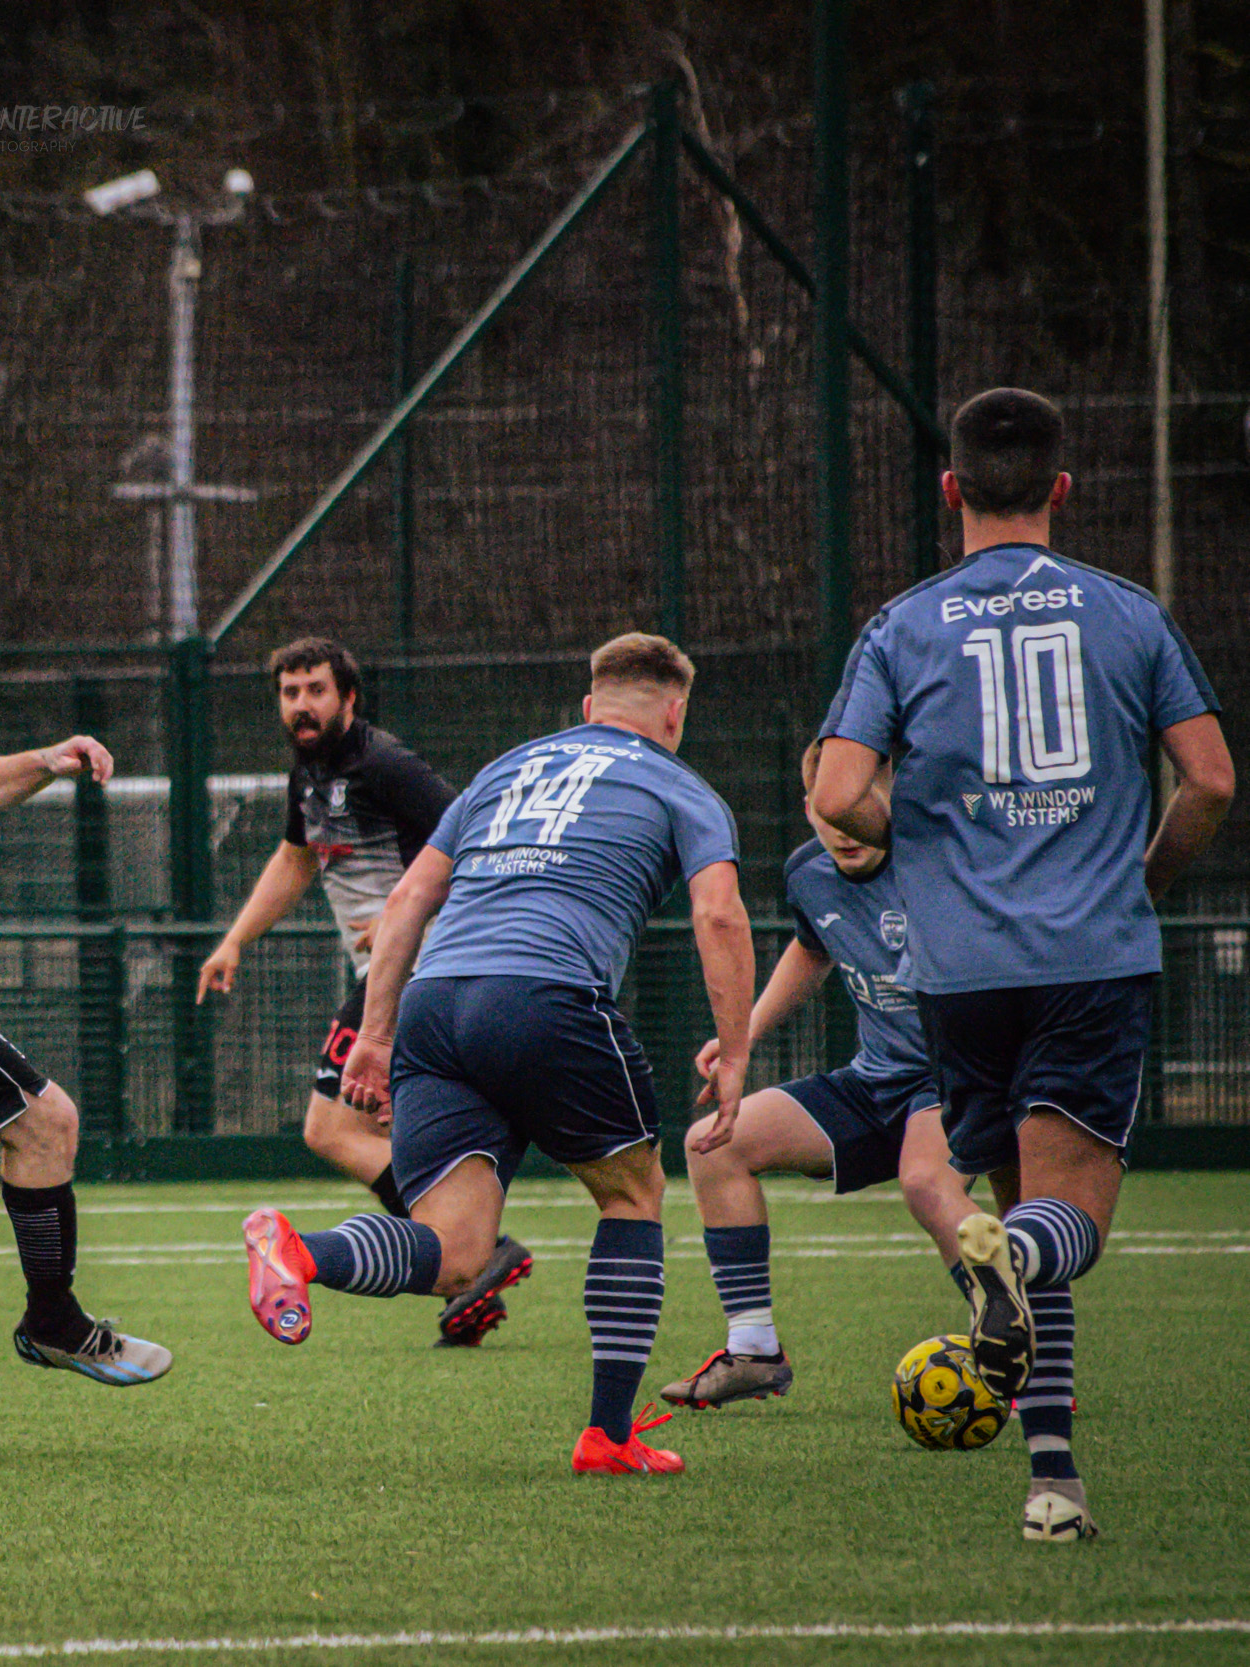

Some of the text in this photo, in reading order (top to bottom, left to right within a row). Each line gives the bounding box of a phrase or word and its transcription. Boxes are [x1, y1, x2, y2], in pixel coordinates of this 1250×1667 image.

[941, 584, 1084, 624] Everest
[962, 620, 1091, 784] 10
[527, 742, 644, 762] Everest
[481, 753, 617, 848] 14
[989, 786, 1096, 810] W2 WINDOW
[1007, 806, 1080, 827] SYSTEMS
[494, 860, 547, 874] SYSTEMS
[506, 846, 569, 866] WINDOW
